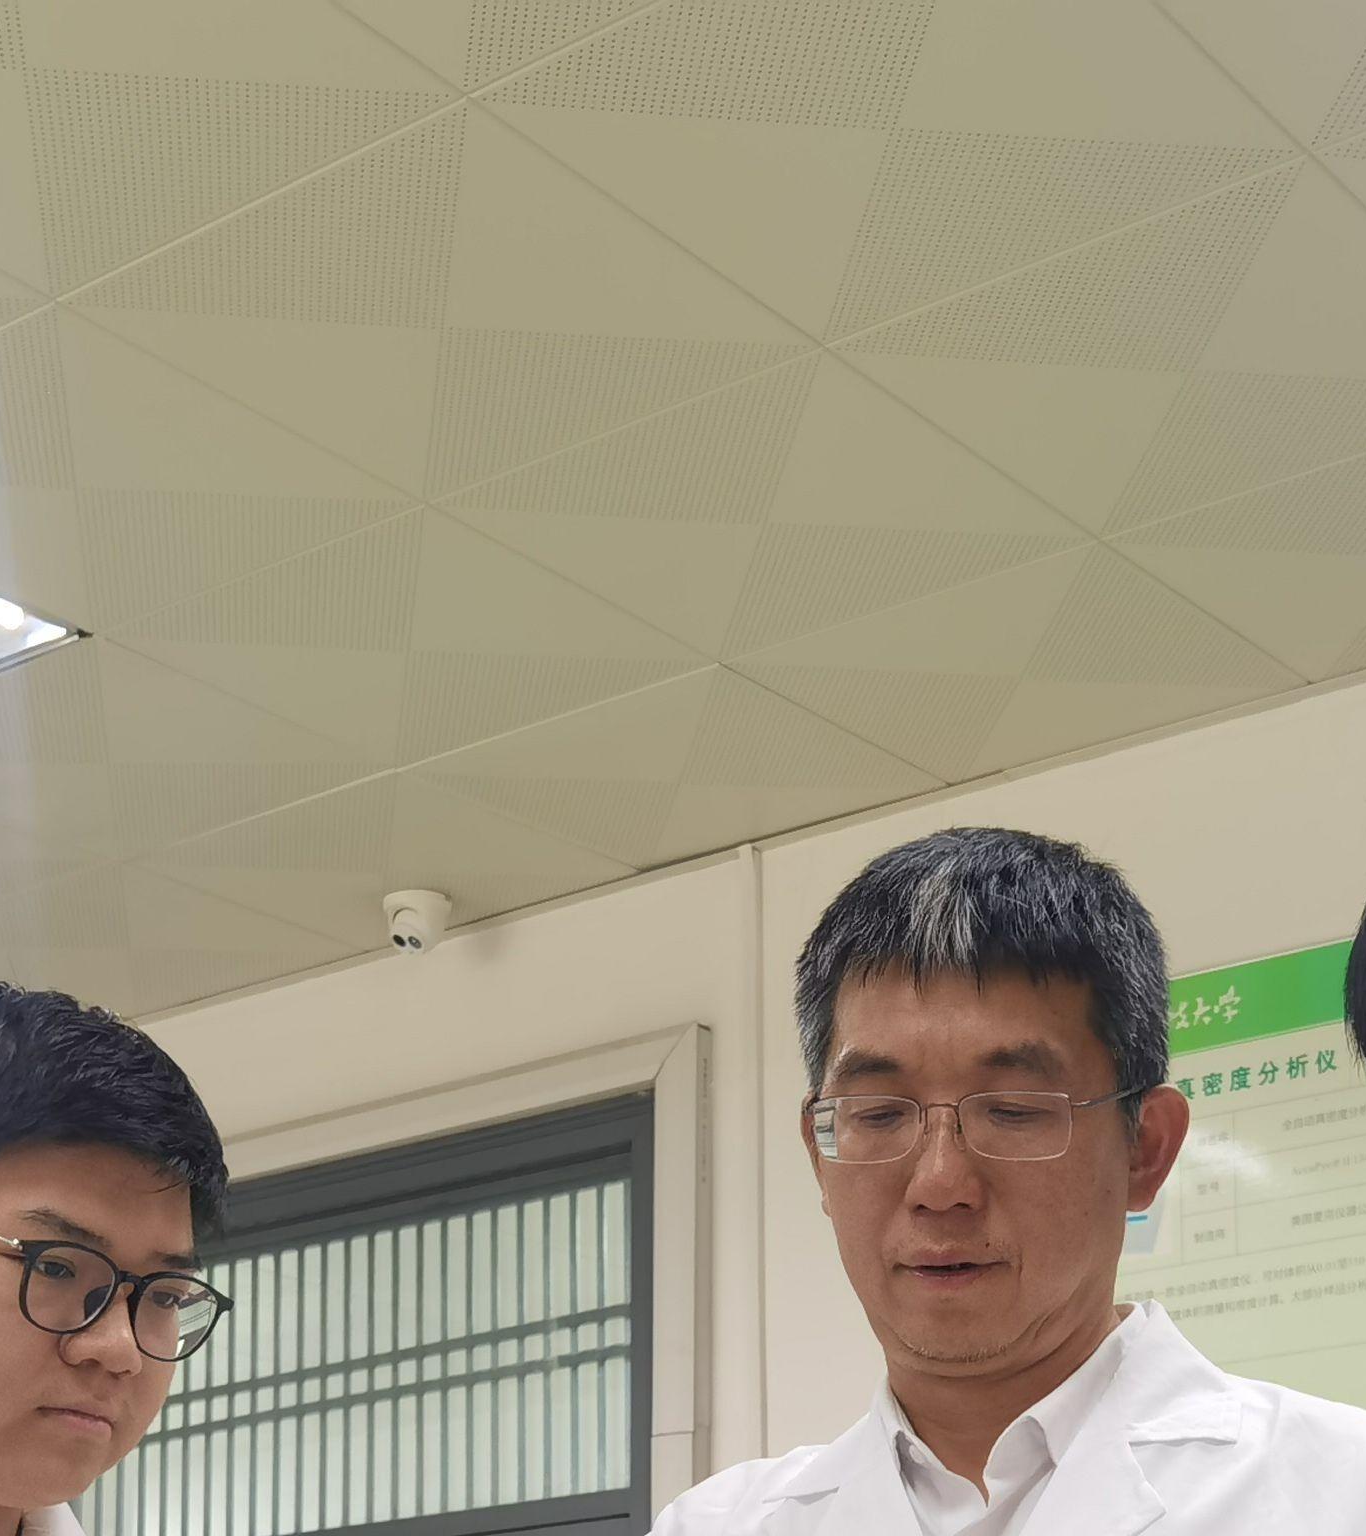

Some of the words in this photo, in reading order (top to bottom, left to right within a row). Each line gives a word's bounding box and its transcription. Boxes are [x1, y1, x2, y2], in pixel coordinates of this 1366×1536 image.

[1175, 1050, 1337, 1100] 真密度分析仪
